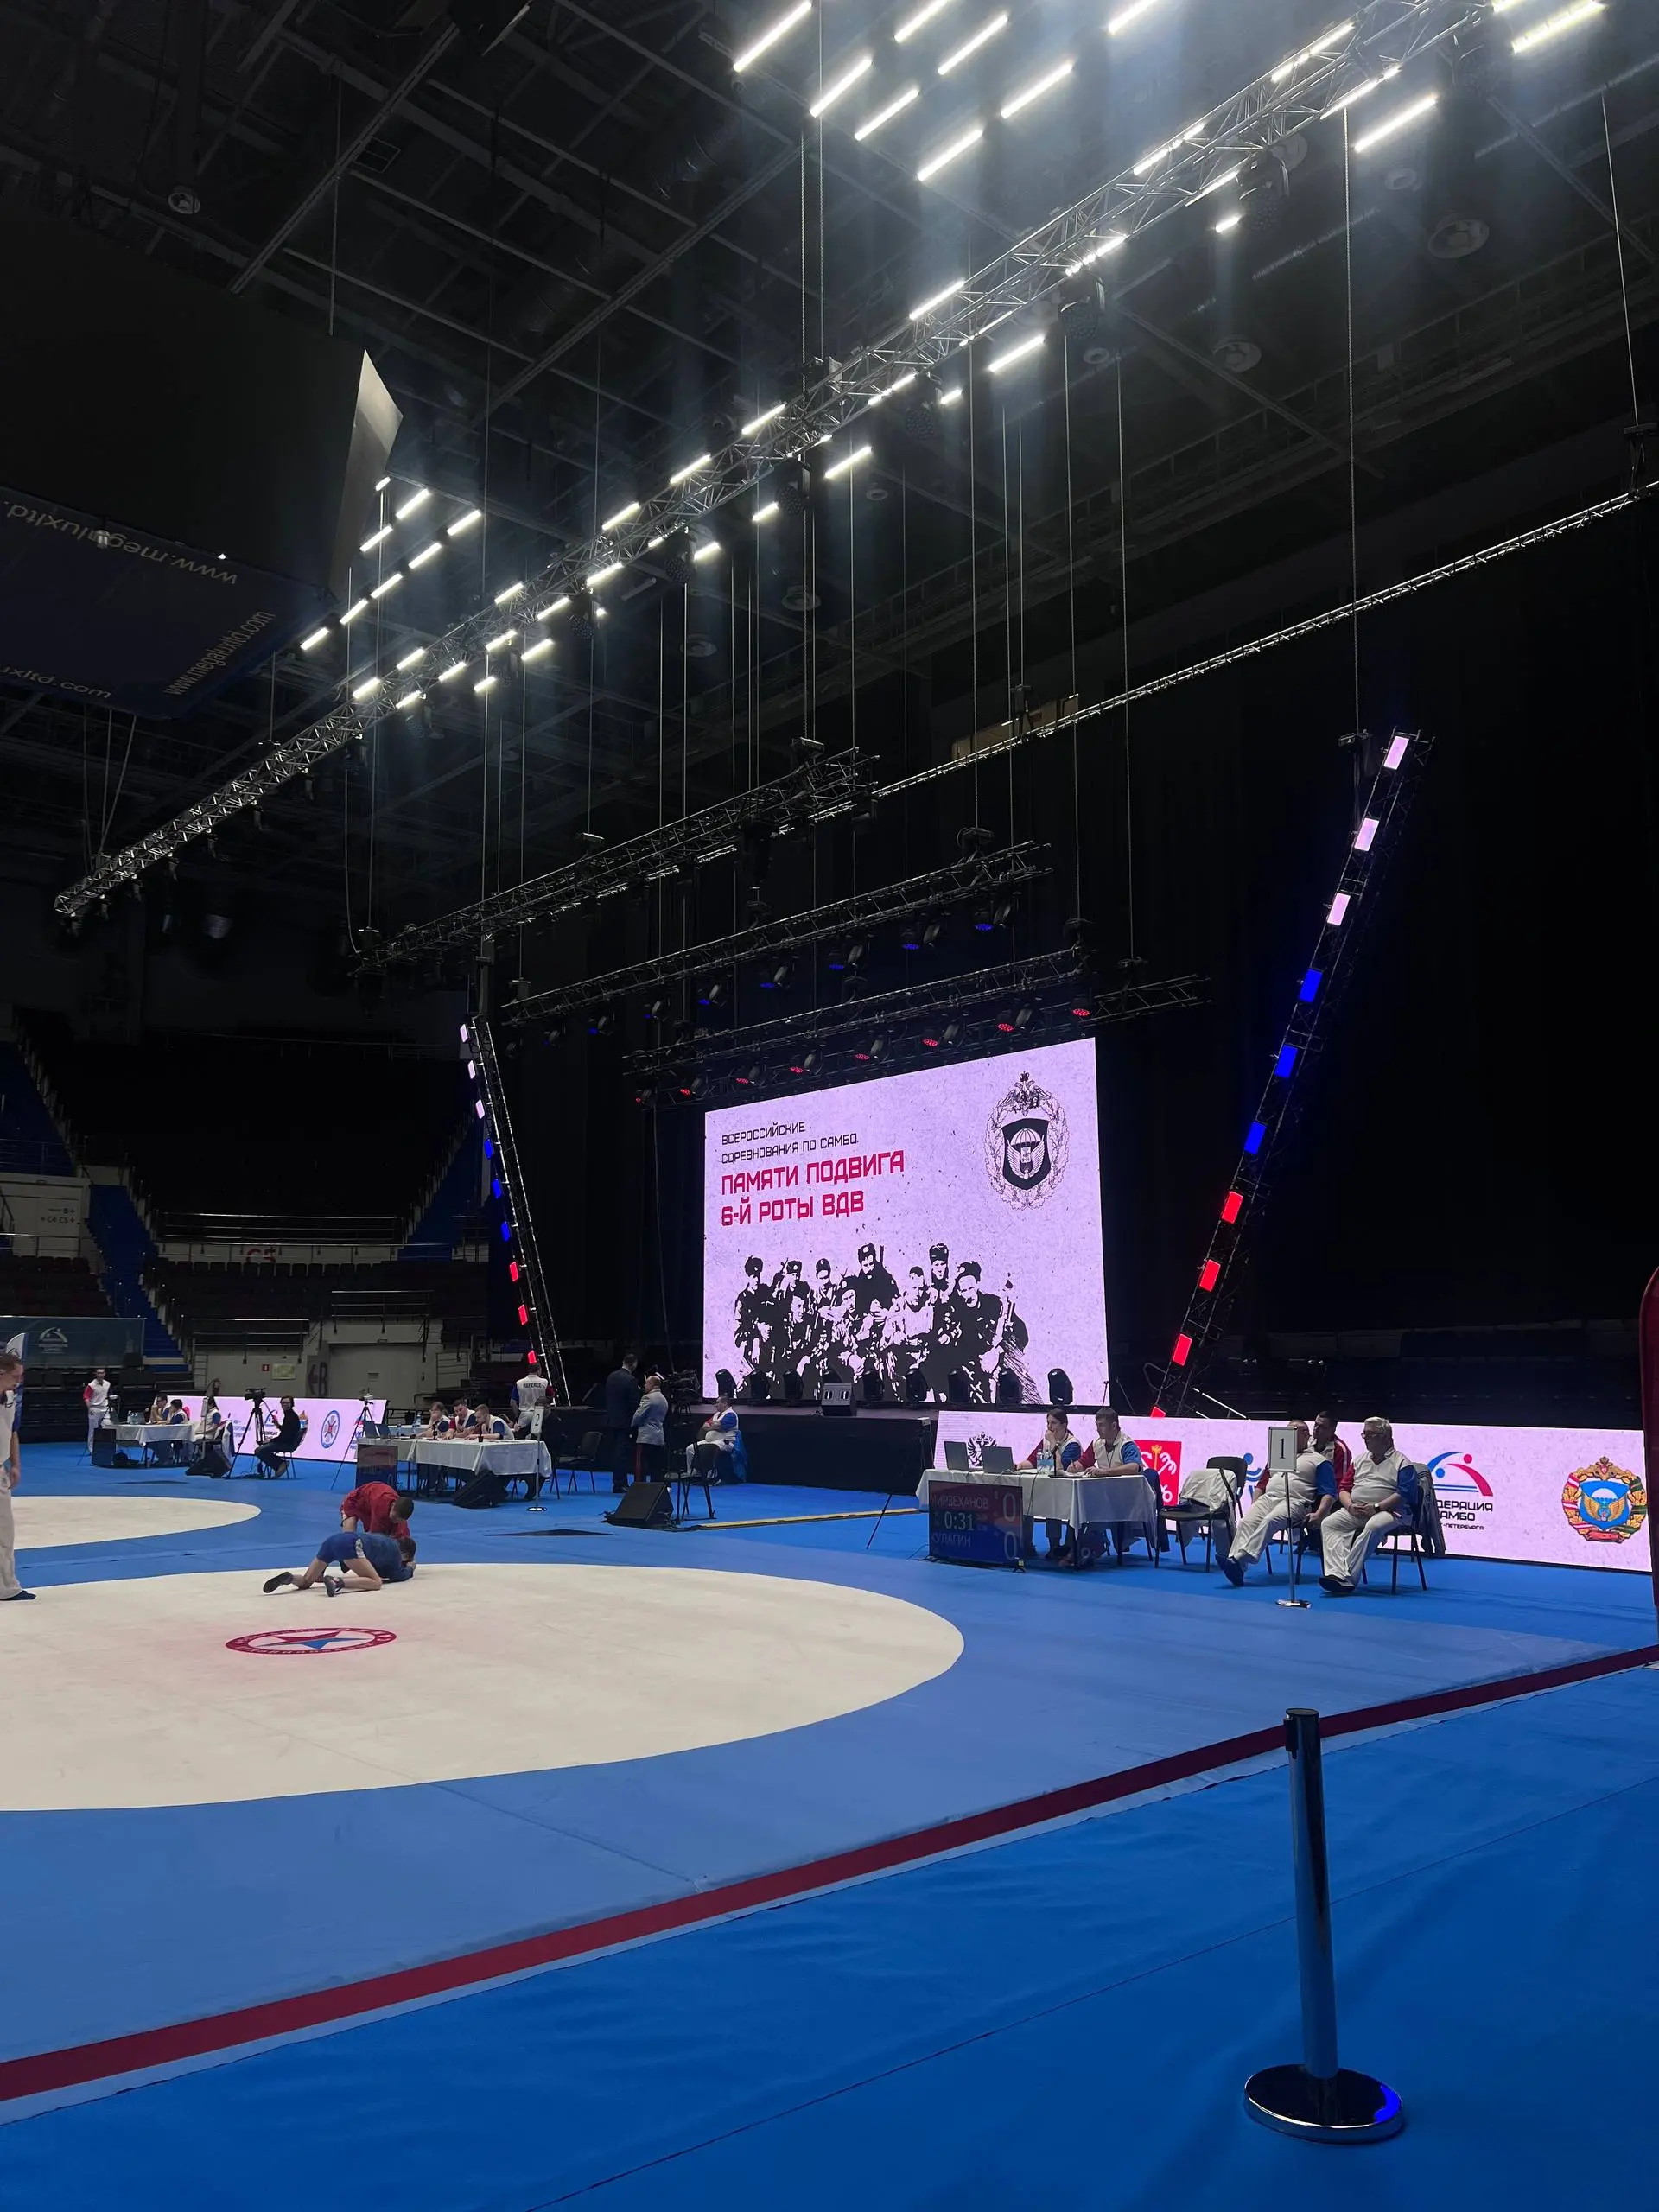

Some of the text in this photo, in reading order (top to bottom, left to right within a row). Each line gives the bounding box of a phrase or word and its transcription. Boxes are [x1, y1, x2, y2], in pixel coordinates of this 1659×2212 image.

[162, 610, 276, 695] www.megaluxltd.com
[721, 1122, 805, 1145] ВСЕРОССИЙСКИЕ
[721, 1133, 857, 1164] СОРЕВНОВАНИЯ ПО САМБО
[721, 1150, 904, 1195] ПАМЯТИ ПОДВИГА
[721, 1190, 864, 1226] 6-Й РОТЫ ВДВ
[535, 1413, 540, 1426] 2
[1279, 1438, 1287, 1459] 1
[1002, 1492, 1016, 1522] 0
[1436, 1500, 1493, 1512] ДЕРАЦИЯ
[1440, 1510, 1475, 1521] АМБО
[944, 1511, 974, 1531] 0:31
[1004, 1531, 1017, 1560] 0
